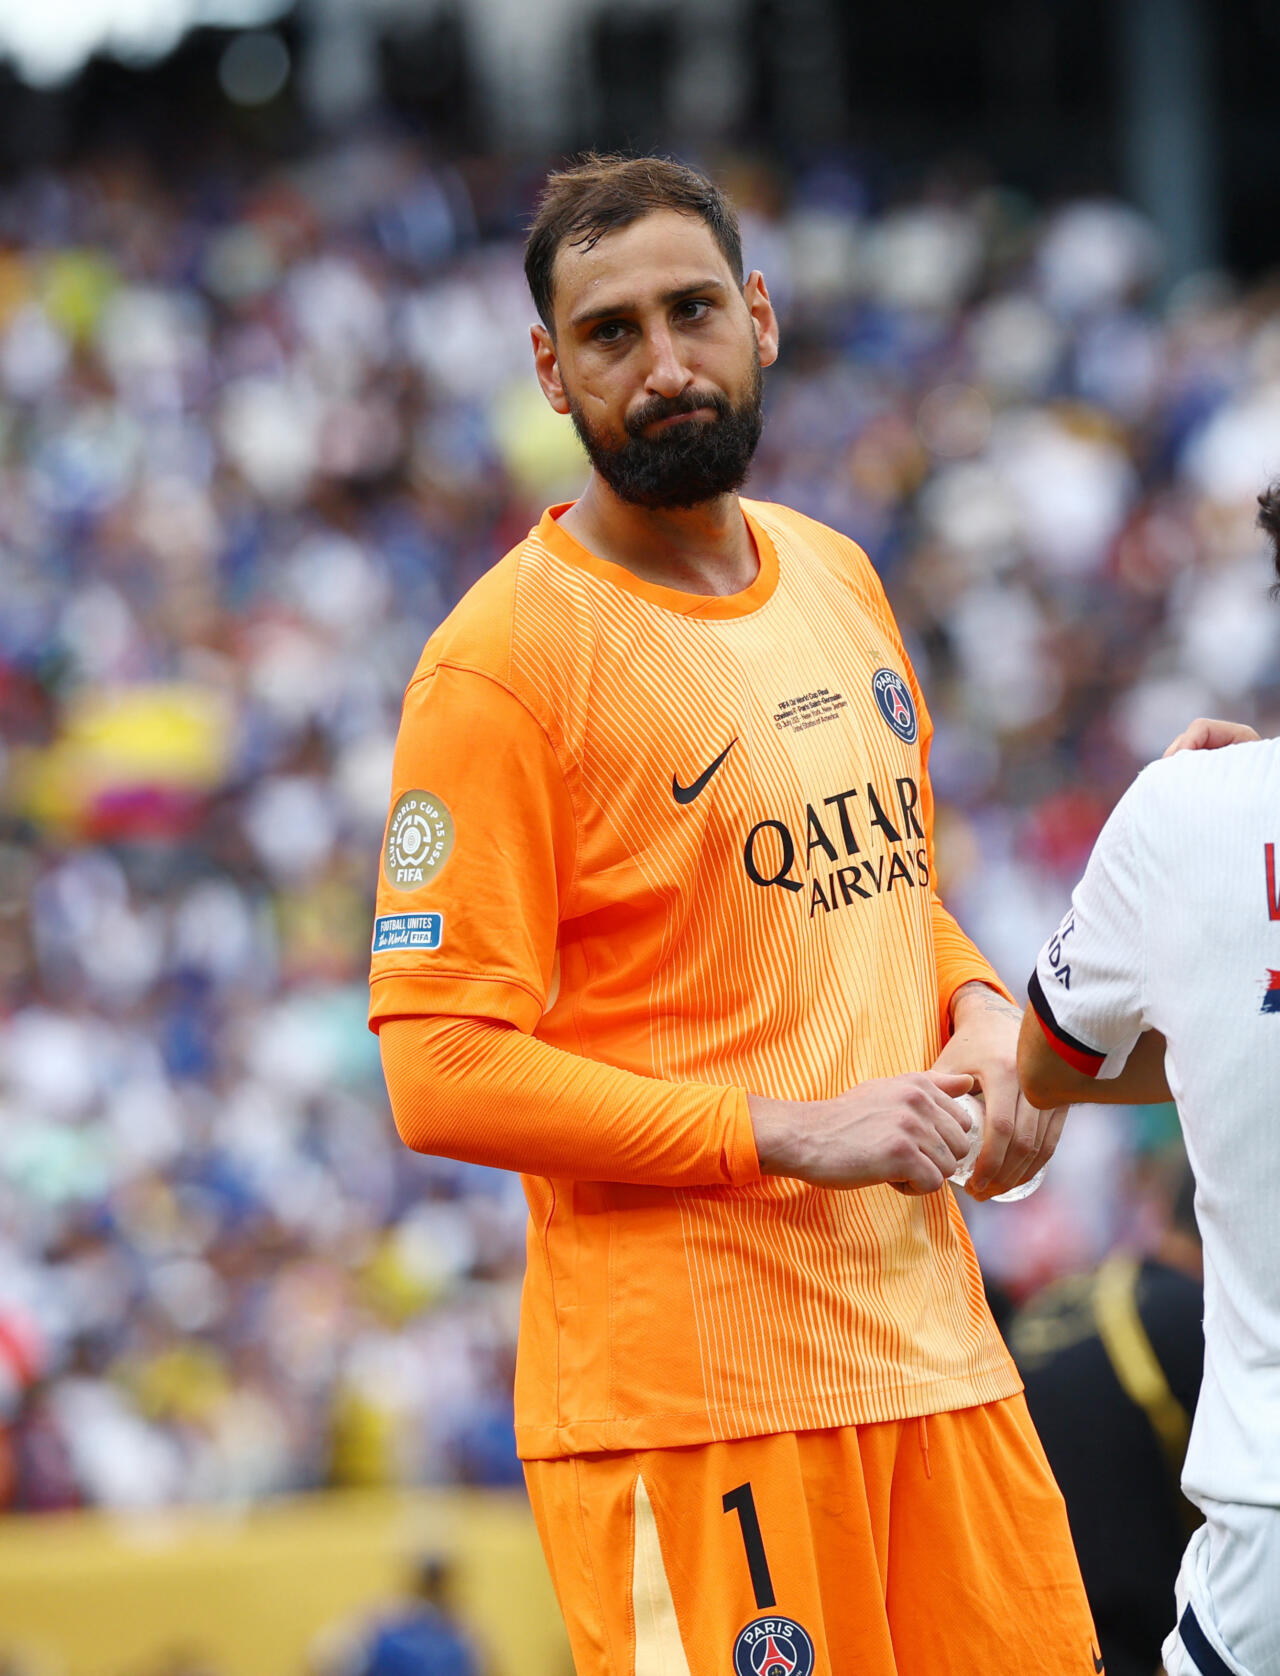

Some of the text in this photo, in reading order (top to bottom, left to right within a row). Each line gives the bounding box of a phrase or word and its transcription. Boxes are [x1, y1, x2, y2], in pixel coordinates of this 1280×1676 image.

[876, 673, 903, 691] PARIS
[392, 800, 417, 831] WORLD
[420, 801, 439, 819] CUP
[435, 821, 445, 837] 25
[744, 777, 925, 893] QATAR
[427, 842, 444, 866] USA
[396, 868, 424, 882] FIFA
[380, 917, 432, 932] FOOTBALL UNITES
[388, 930, 409, 946] World
[722, 1481, 777, 1610] 1
[743, 1622, 794, 1645] PARIS
